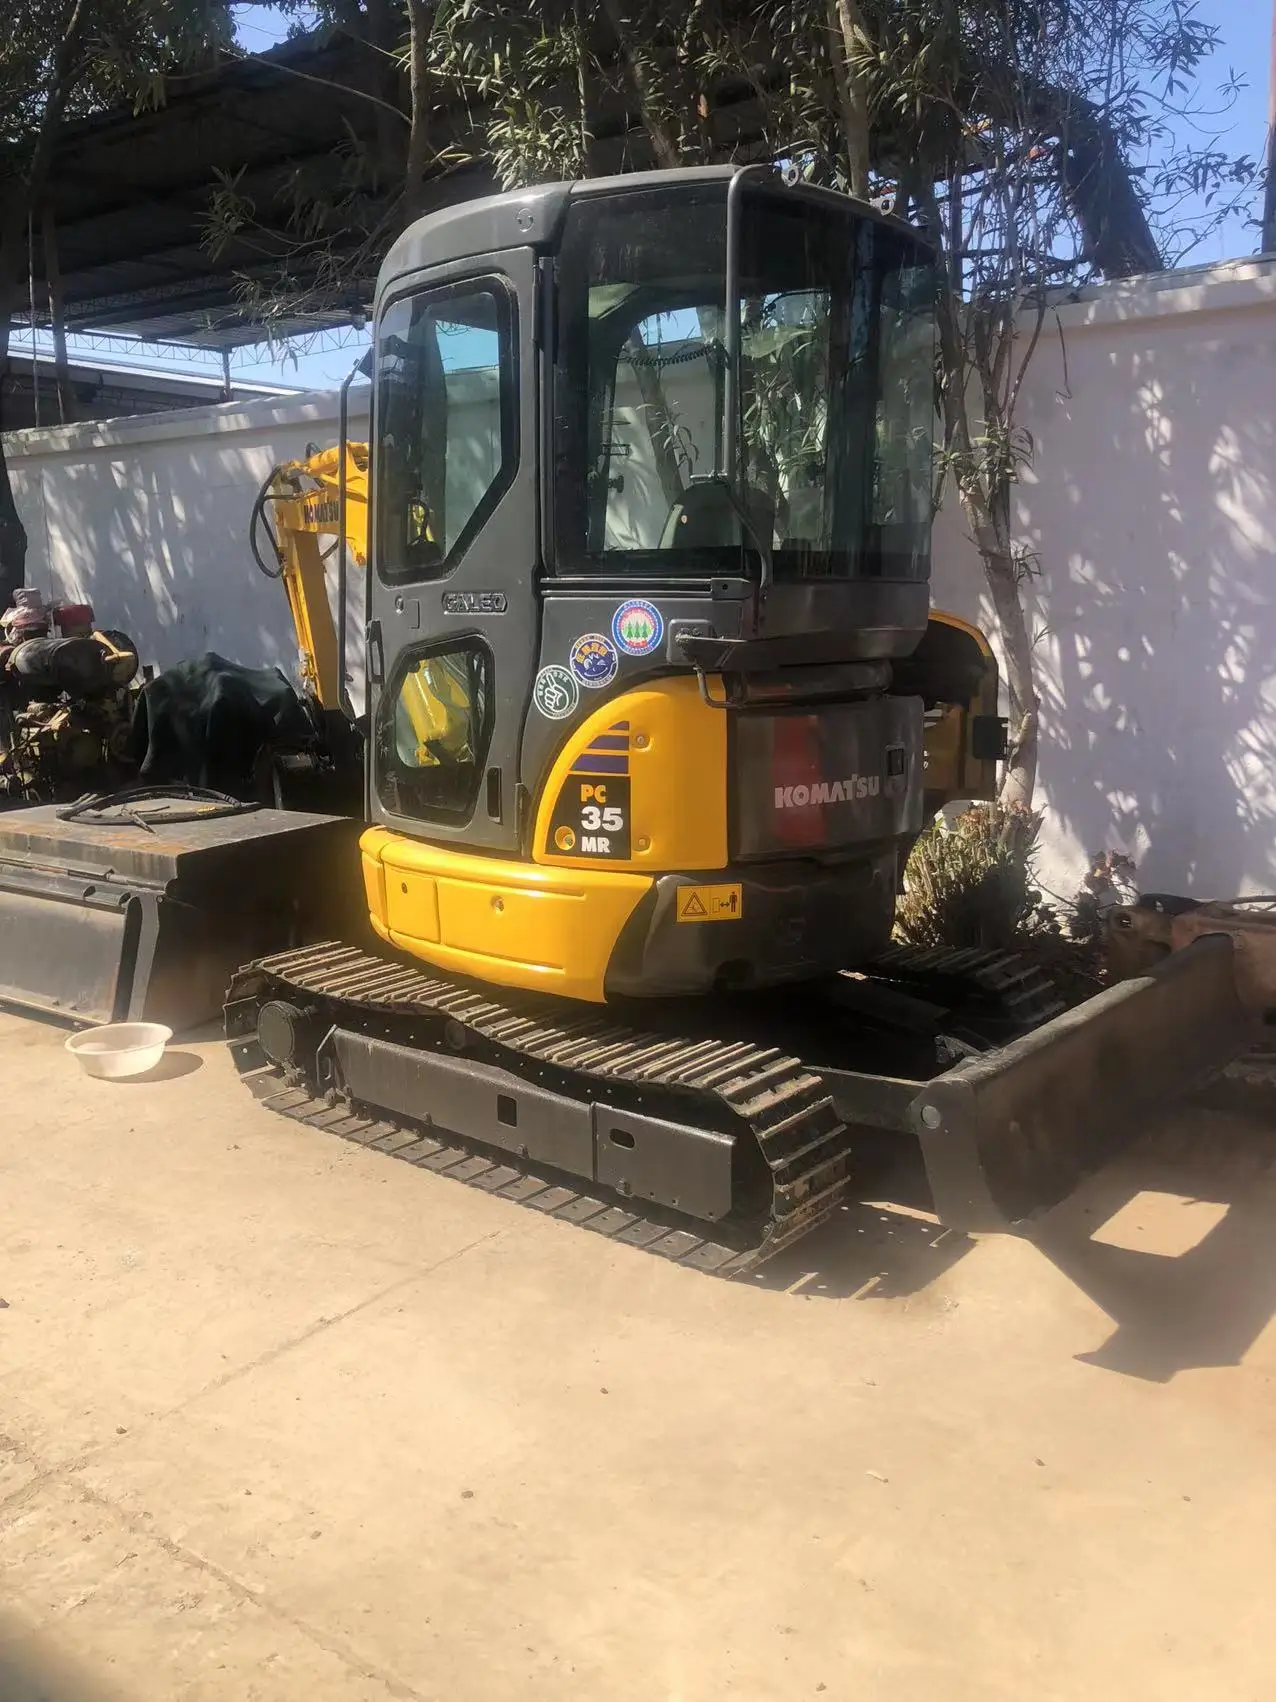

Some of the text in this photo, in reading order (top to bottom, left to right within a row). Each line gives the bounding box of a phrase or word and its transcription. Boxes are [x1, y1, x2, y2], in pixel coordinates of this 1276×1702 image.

[581, 784, 606, 803] PC
[775, 774, 880, 808] KOMATSU
[581, 806, 623, 831] 35
[581, 836, 611, 853] MR
